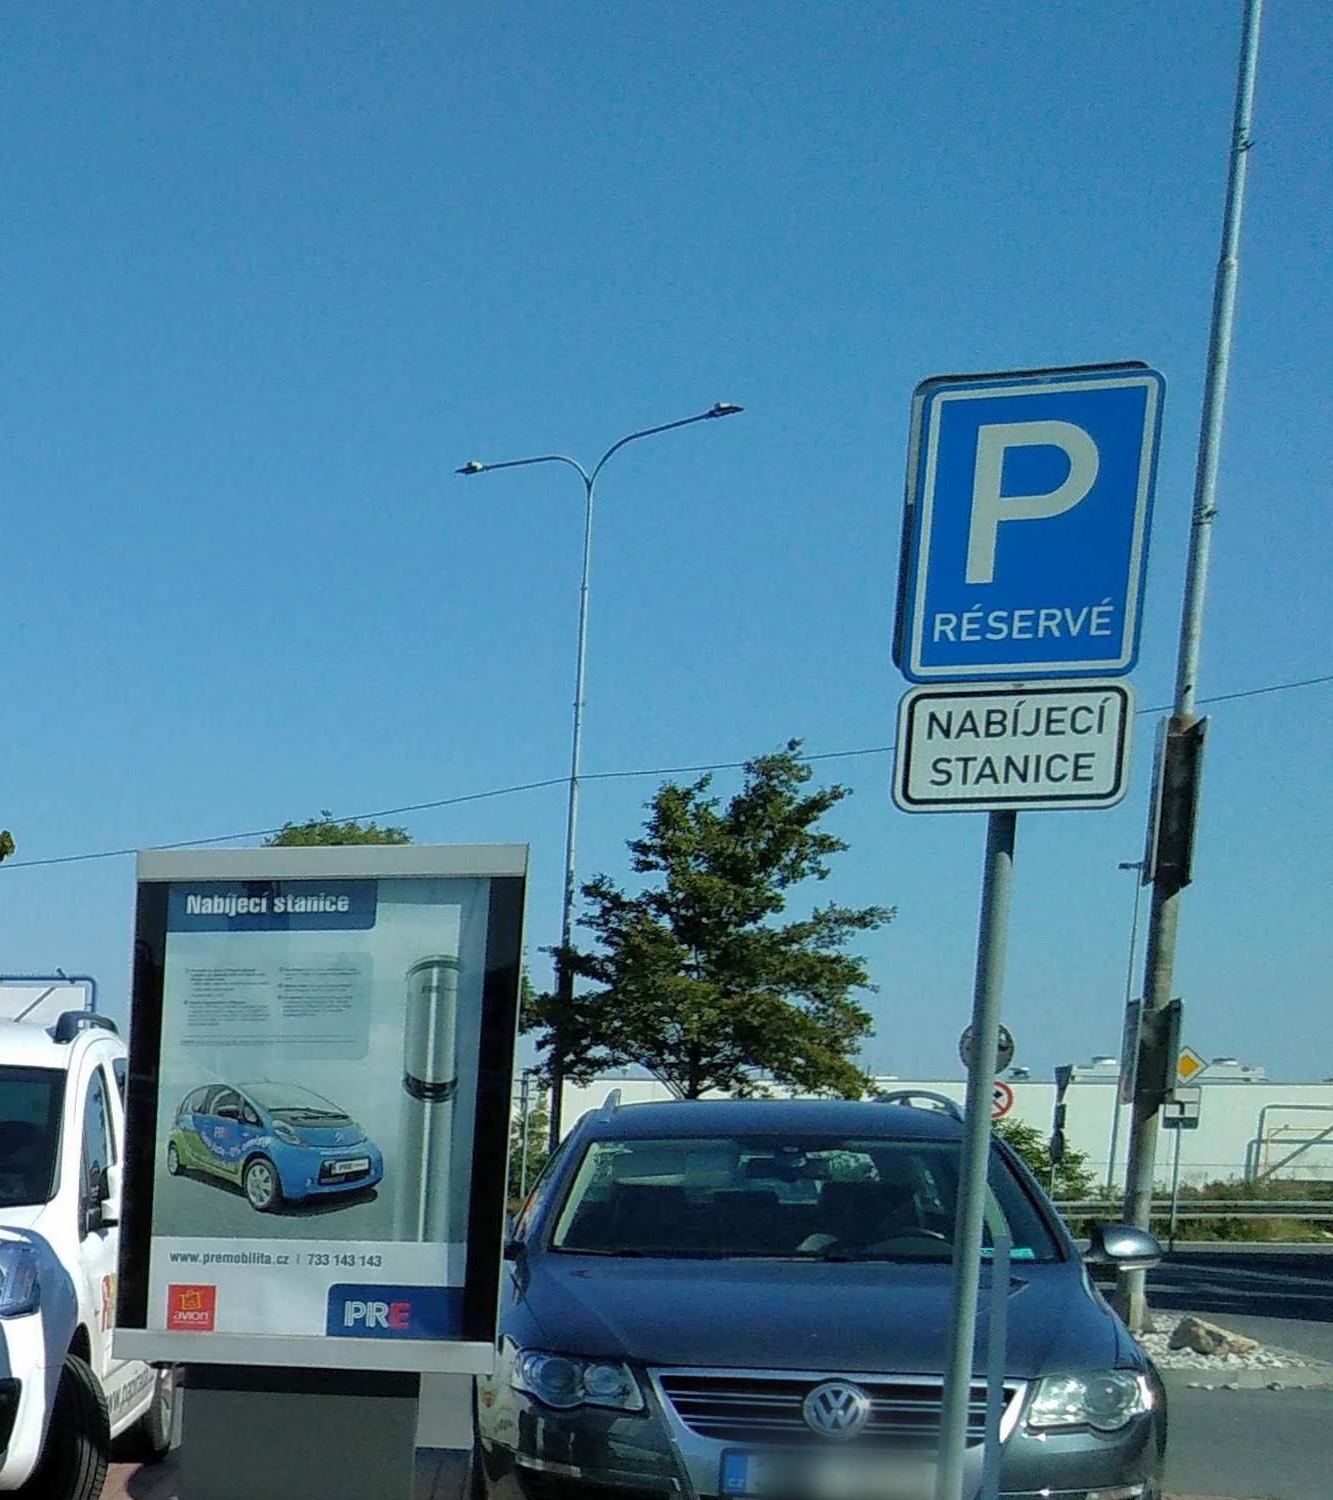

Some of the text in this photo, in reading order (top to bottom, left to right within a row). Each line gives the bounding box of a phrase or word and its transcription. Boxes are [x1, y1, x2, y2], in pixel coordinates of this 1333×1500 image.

[964, 420, 1100, 585] P
[933, 597, 1115, 642] RÉSERVÉ
[926, 697, 1112, 740] NABÍJECÍ
[929, 752, 1096, 786] STANICE
[186, 891, 350, 917] Nabíjecí stanice
[170, 1251, 290, 1265] www.premobilita.cz
[307, 1253, 330, 1266] 733
[334, 1254, 356, 1267] 143
[359, 1254, 383, 1267] 143
[172, 1310, 209, 1321] avion
[344, 1299, 411, 1330] PRE
